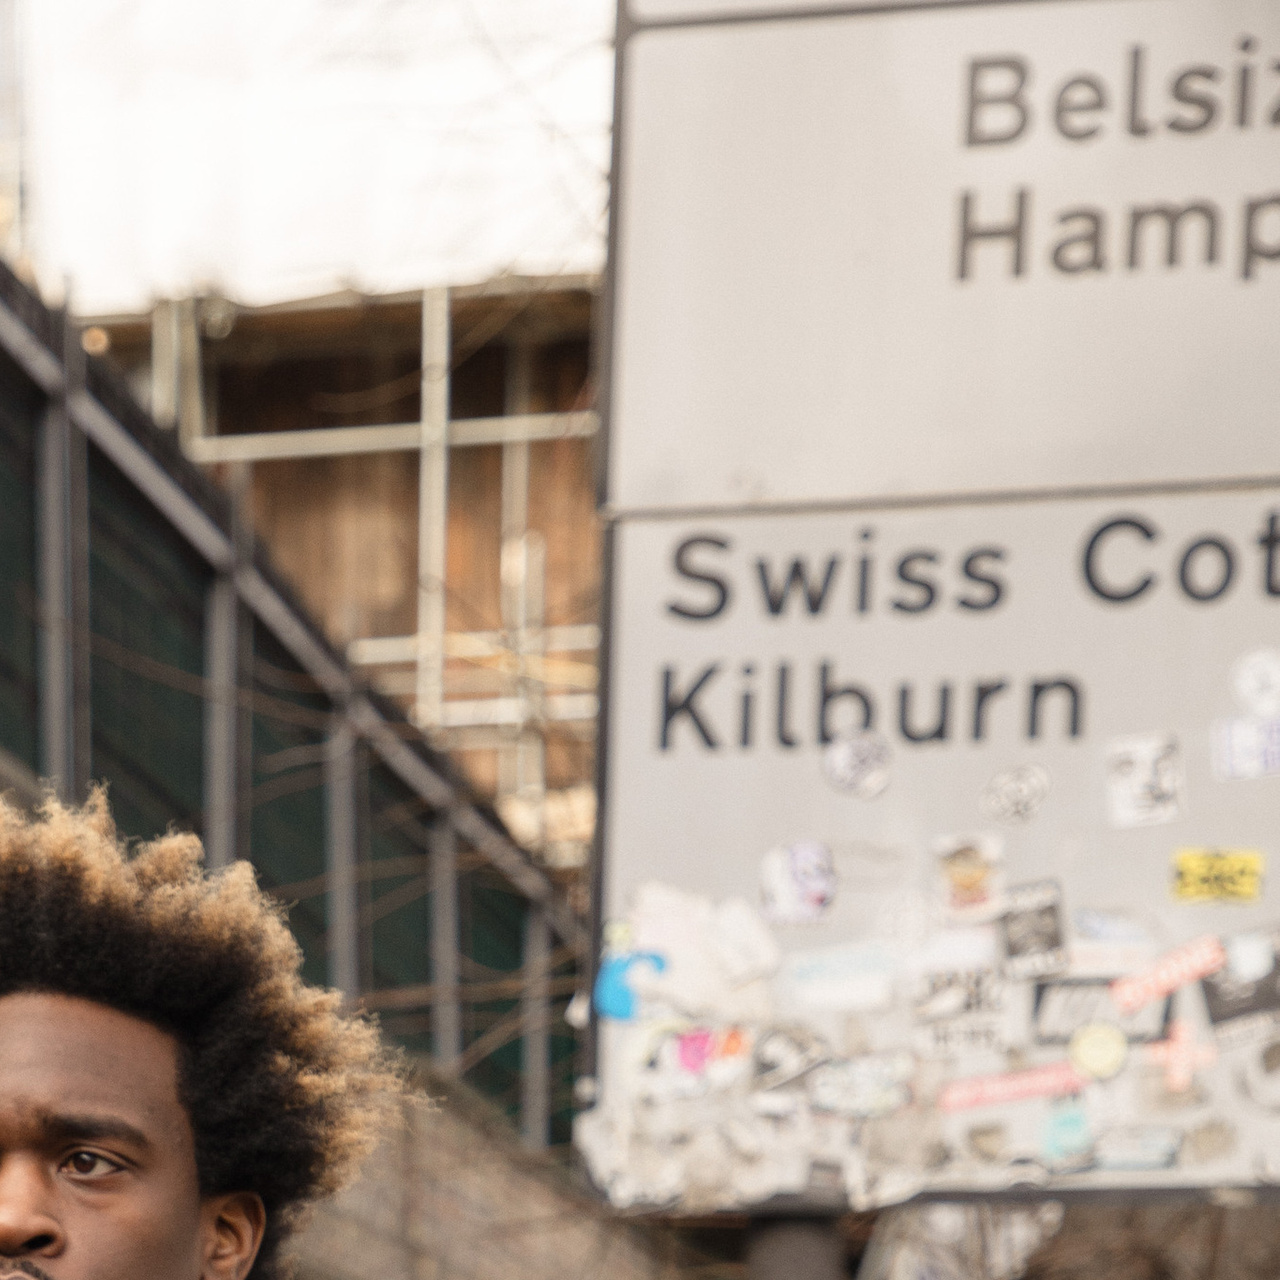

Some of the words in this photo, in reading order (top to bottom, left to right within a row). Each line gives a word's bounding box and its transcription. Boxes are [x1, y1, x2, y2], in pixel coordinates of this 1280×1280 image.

[956, 186, 1280, 281] Hamp
[666, 529, 1006, 621] Swiss
[1081, 512, 1280, 603] Cot
[658, 659, 1086, 752] Kilburn
